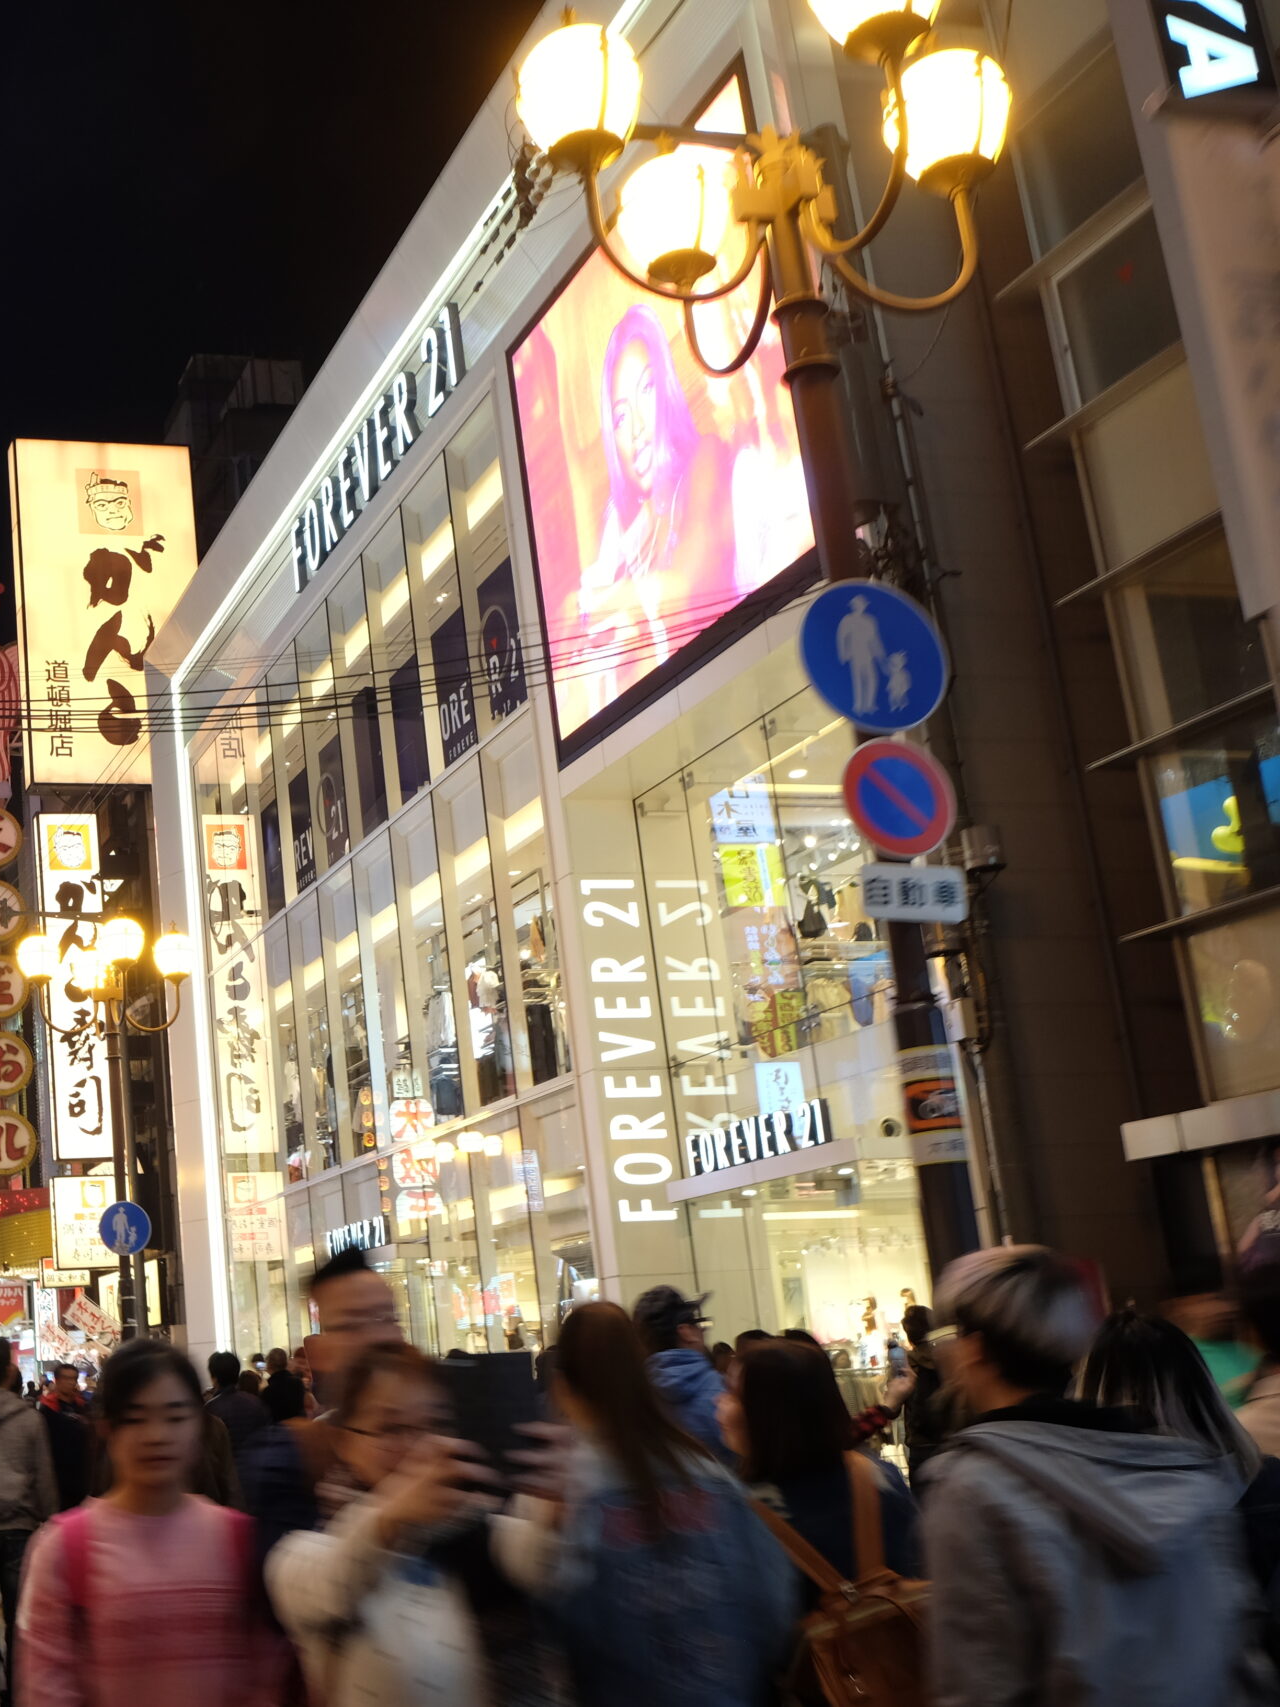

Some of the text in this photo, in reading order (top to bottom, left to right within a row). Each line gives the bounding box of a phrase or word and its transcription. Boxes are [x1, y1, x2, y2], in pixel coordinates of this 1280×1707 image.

[291, 302, 466, 594] FOREVER 21
[44, 660, 74, 758] 道頓堀店
[82, 533, 167, 746] がんこ
[580, 878, 678, 1223] FOREVER 21
[685, 1098, 826, 1177] FOREVER 21
[326, 1215, 386, 1260] FOREVER 21
